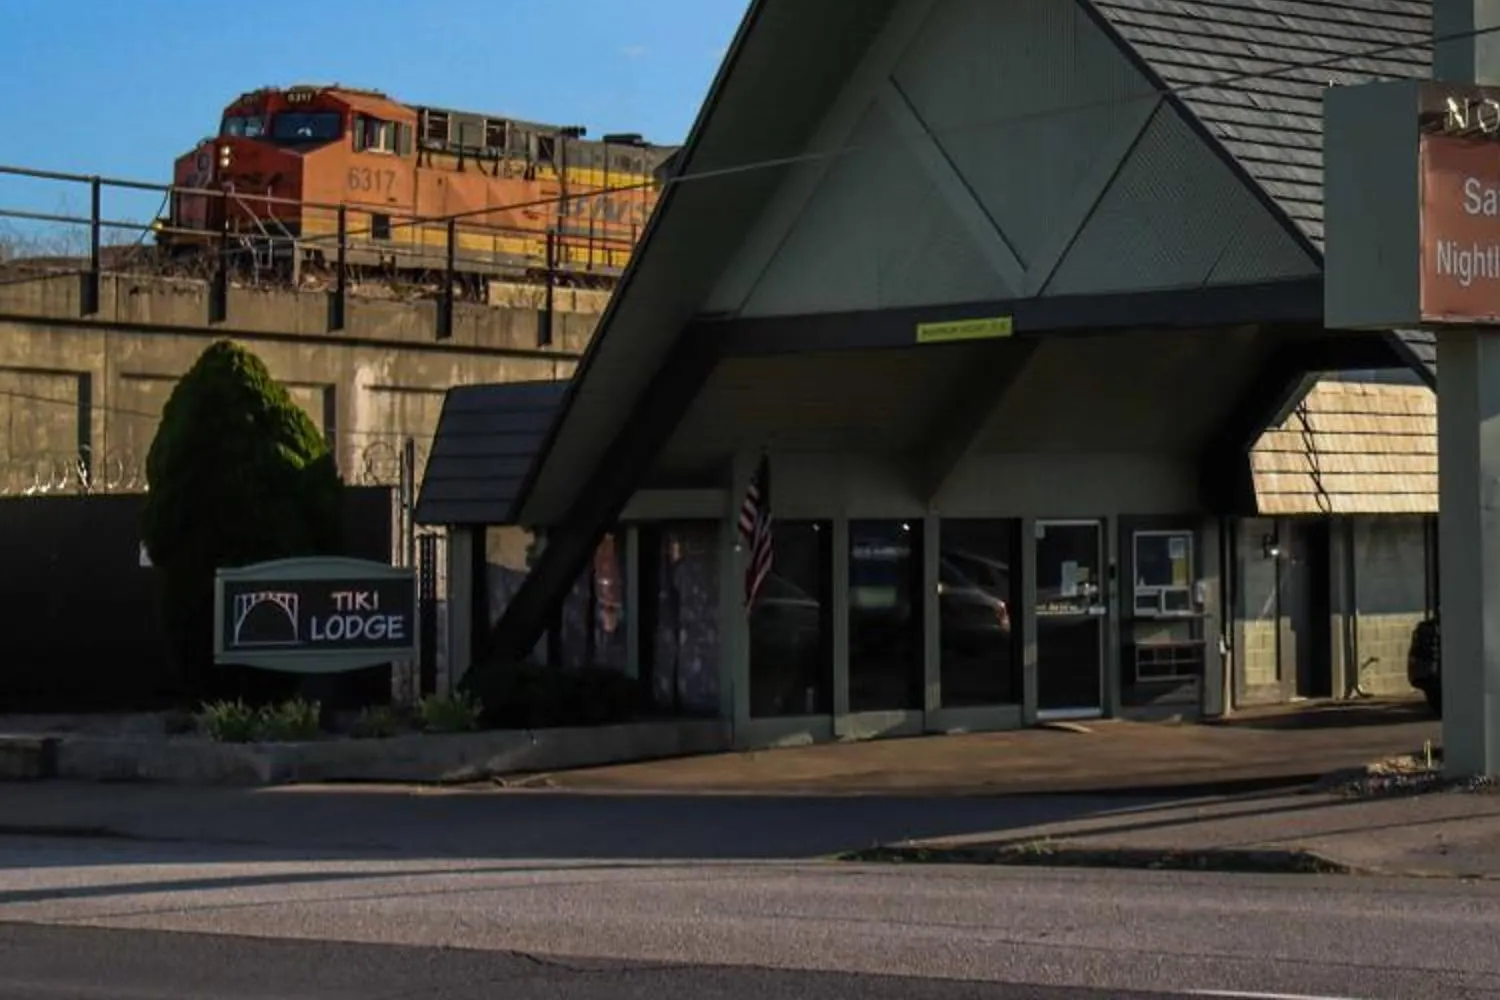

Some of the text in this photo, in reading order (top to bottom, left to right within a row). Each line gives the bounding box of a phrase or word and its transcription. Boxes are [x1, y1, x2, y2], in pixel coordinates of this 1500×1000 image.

[1446, 97, 1500, 134] NO
[346, 167, 396, 192] 6317
[329, 591, 379, 612] TIKI
[310, 615, 405, 640] LODGE
